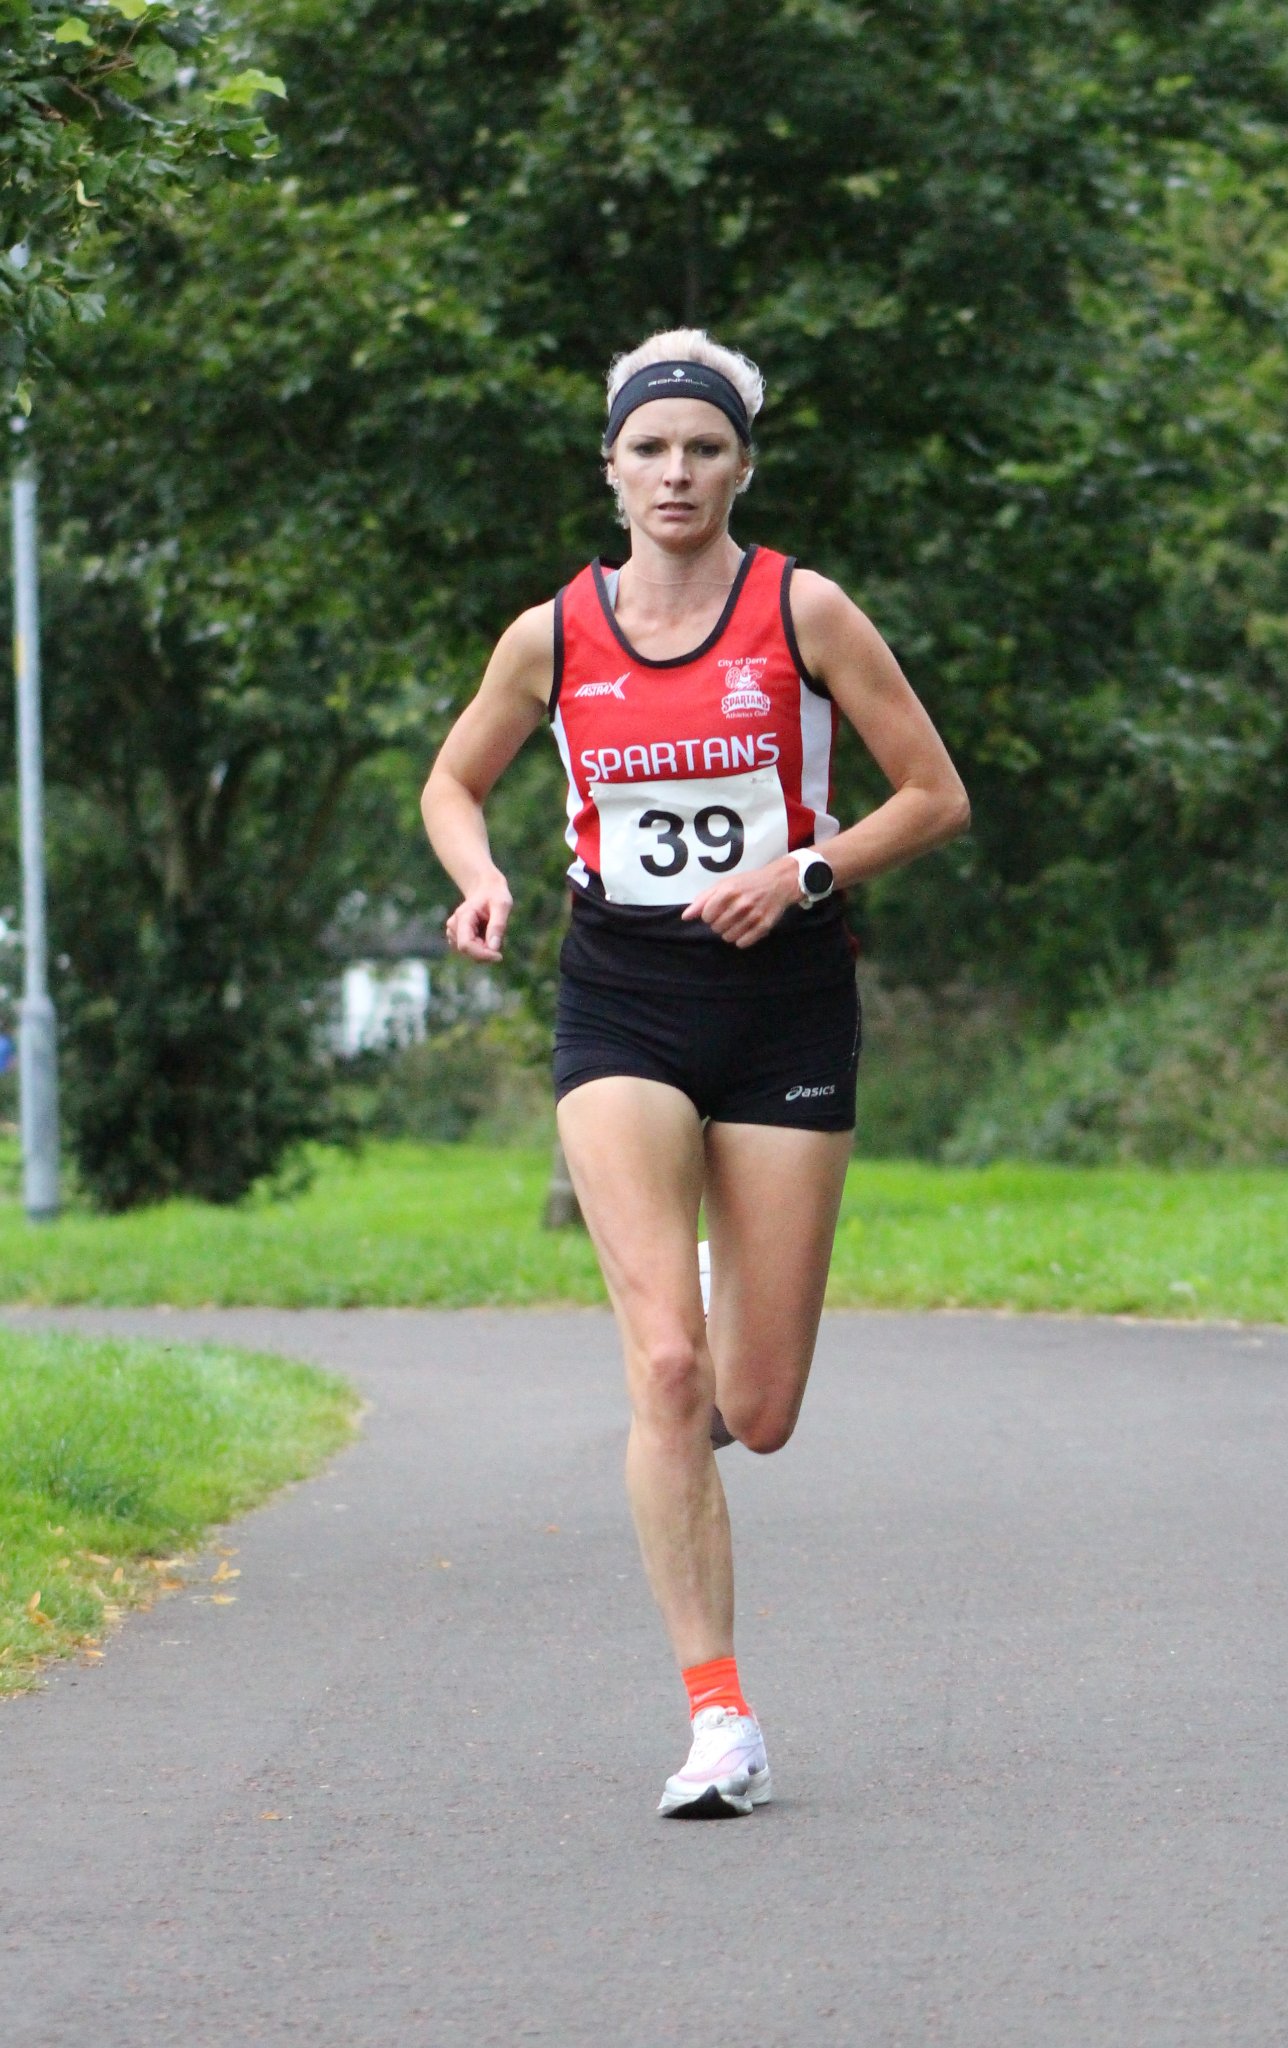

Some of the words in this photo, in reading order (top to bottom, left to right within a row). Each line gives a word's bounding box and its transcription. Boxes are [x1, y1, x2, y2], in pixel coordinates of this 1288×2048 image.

[718, 659, 733, 668] City
[735, 657, 743, 666] of
[746, 656, 767, 665] Derry
[723, 695, 768, 712] SPARTANS
[580, 733, 780, 782] SPARTANS
[639, 805, 745, 877] 39
